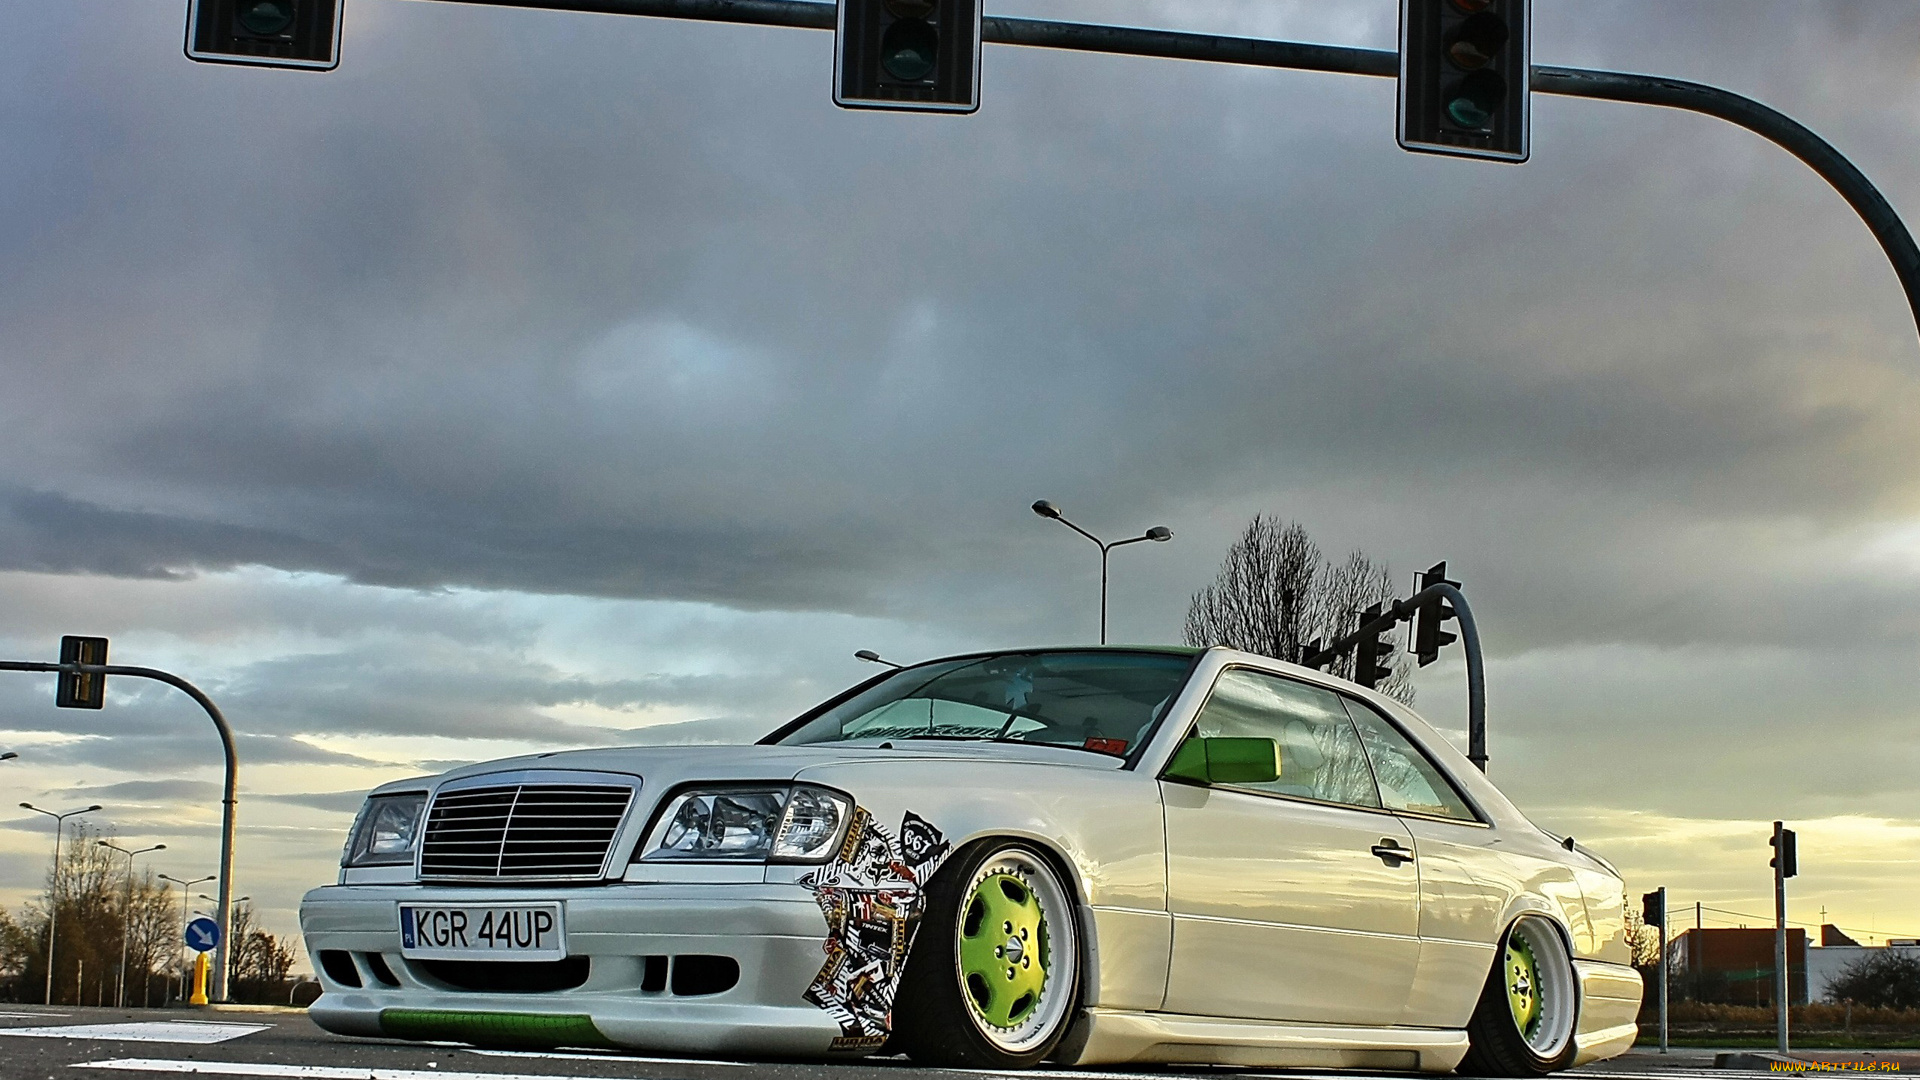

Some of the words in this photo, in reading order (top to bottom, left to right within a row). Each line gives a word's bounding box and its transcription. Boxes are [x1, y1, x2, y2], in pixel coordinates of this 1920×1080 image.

[405, 935, 413, 943] PL
[416, 911, 468, 947] KGR
[478, 911, 552, 948] 44UP
